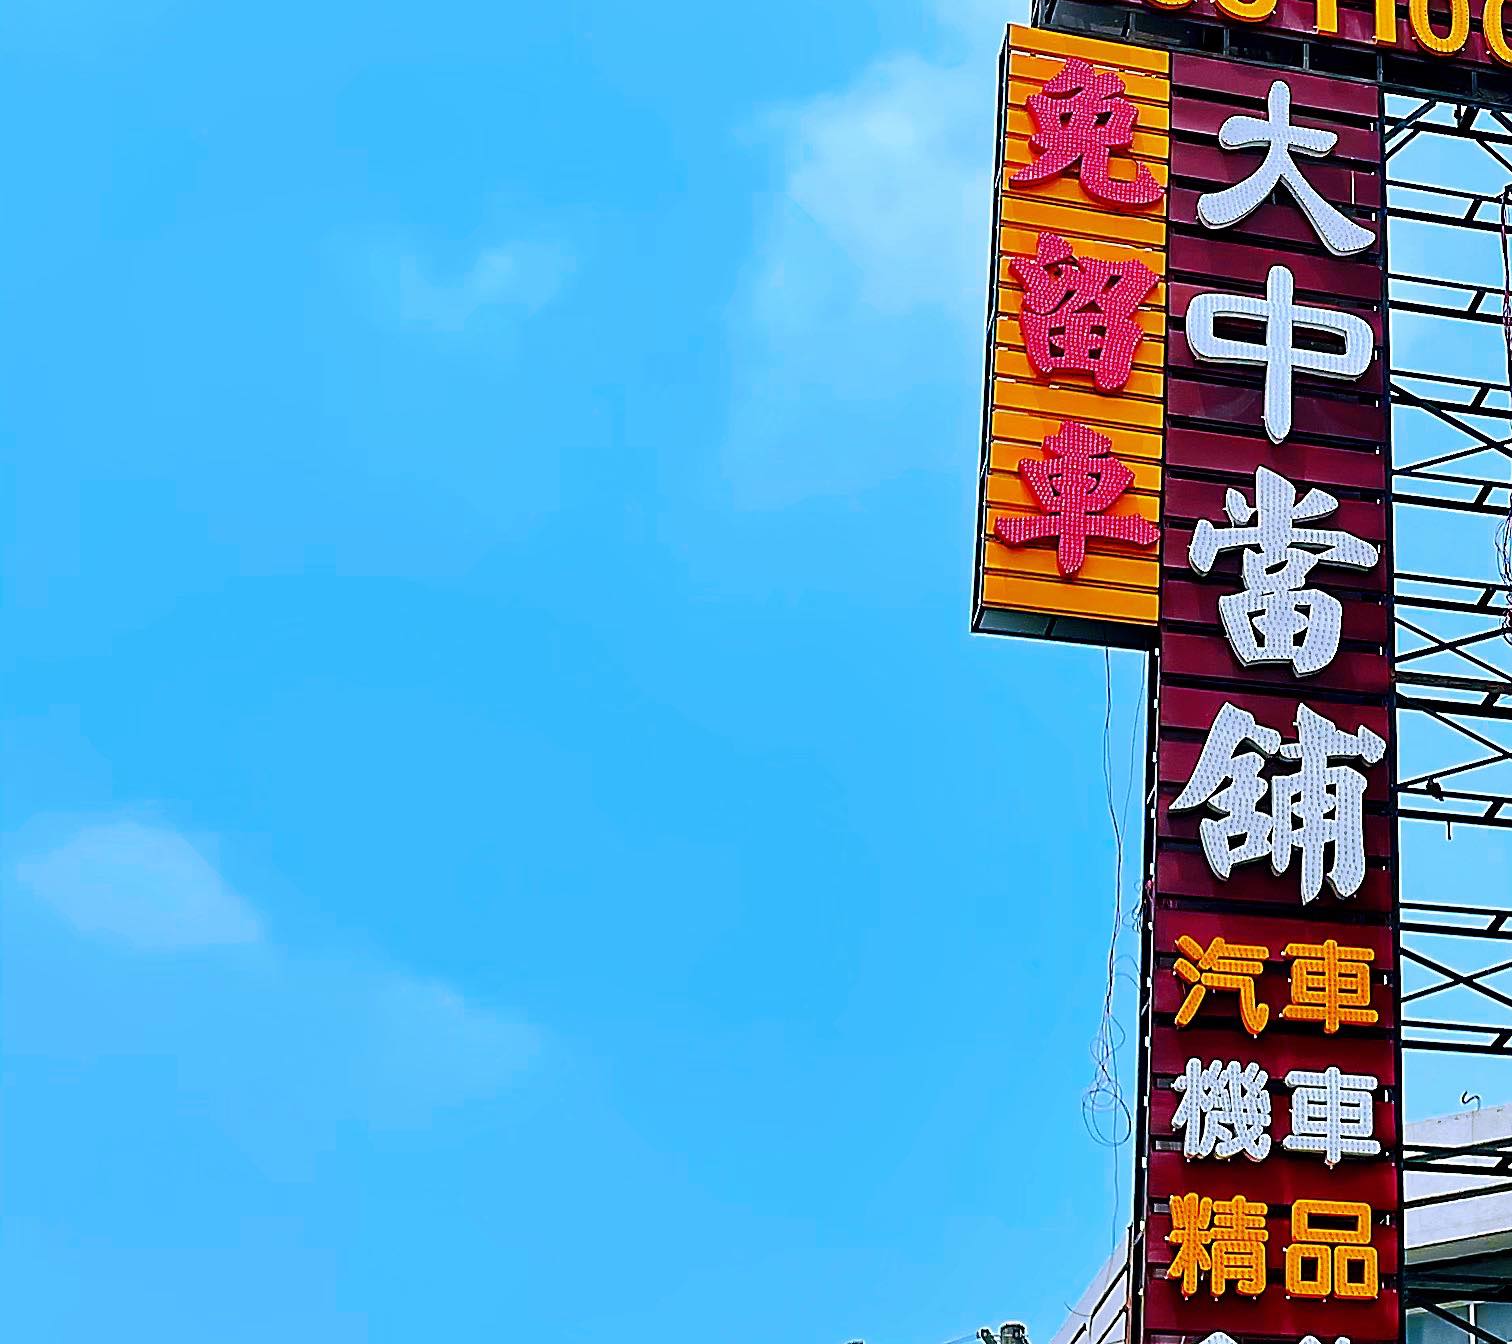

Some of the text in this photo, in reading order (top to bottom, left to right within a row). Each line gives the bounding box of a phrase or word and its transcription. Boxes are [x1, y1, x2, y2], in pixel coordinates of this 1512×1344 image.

[995, 57, 1167, 579] 免留車
[1169, 79, 1387, 906] 大中當舖
[1173, 934, 1380, 1039] 汽車
[1172, 1057, 1382, 1167] 機車
[1166, 1194, 1380, 1302] 精品
